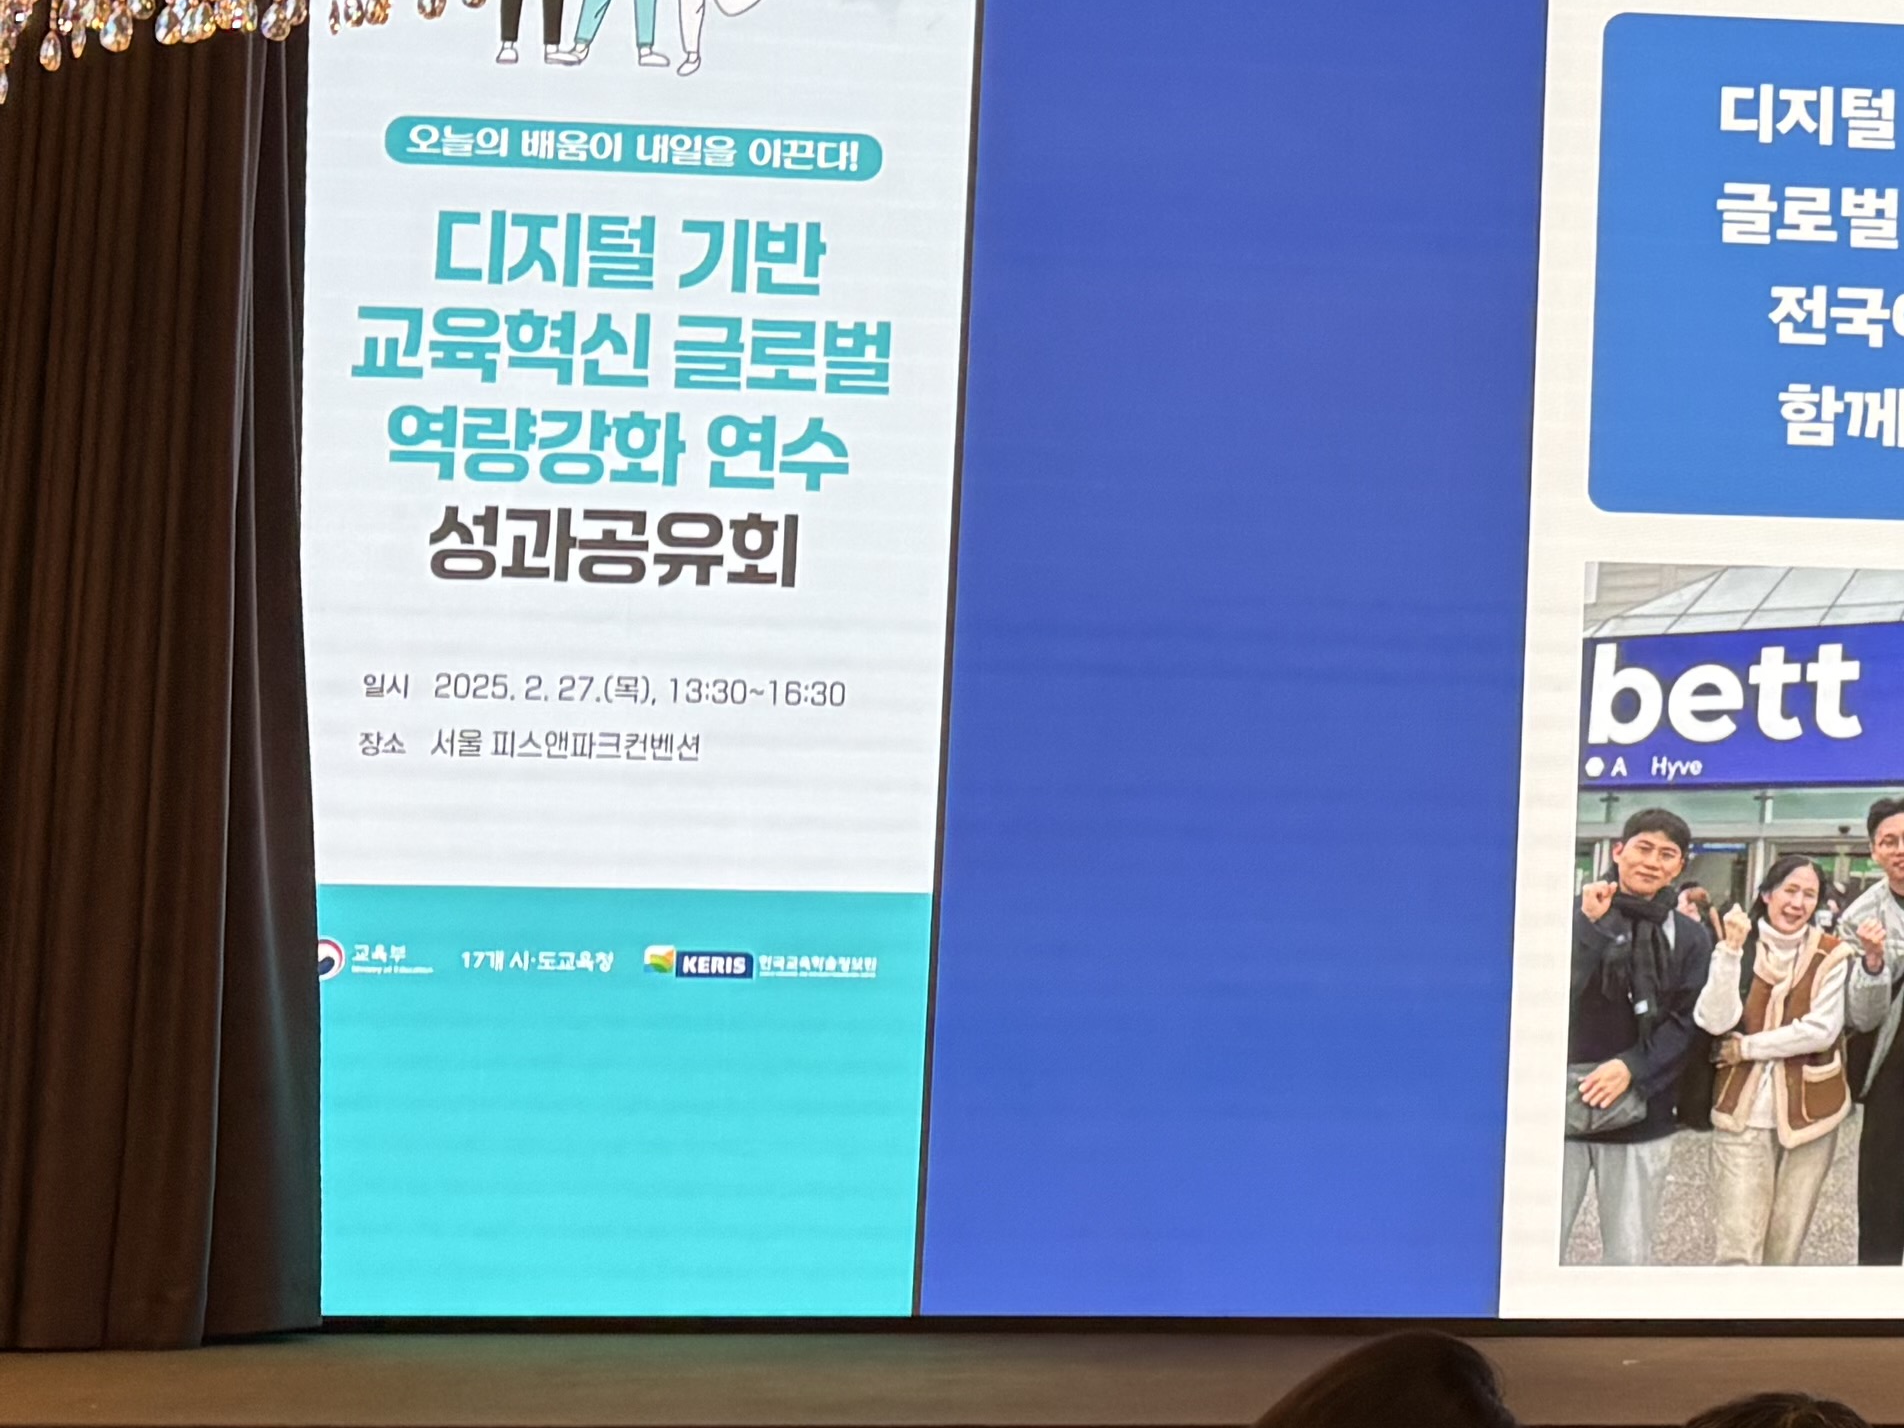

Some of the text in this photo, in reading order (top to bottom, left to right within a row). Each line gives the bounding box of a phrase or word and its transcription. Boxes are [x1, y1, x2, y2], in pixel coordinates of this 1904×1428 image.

[407, 125, 858, 171] 오늘의 배움이 내일을 이끈다!
[1720, 84, 1895, 149] 디지털
[1717, 183, 1898, 249] 글로벌
[435, 210, 826, 296] 디지털 기반
[351, 306, 891, 395] 교육혁신 글로벌
[388, 405, 849, 491] 역량강화 연수
[430, 506, 798, 587] 성과공유회
[364, 674, 408, 698] 일시
[435, 673, 514, 700] 2025.
[525, 676, 548, 701] 2.
[671, 678, 845, 706] 13:30~16:30
[1588, 643, 1862, 744] bett
[360, 729, 699, 761] 장소 서울 피스앤파크컨벤션
[1652, 756, 1702, 781] Hyve
[683, 956, 745, 974] KERIS
